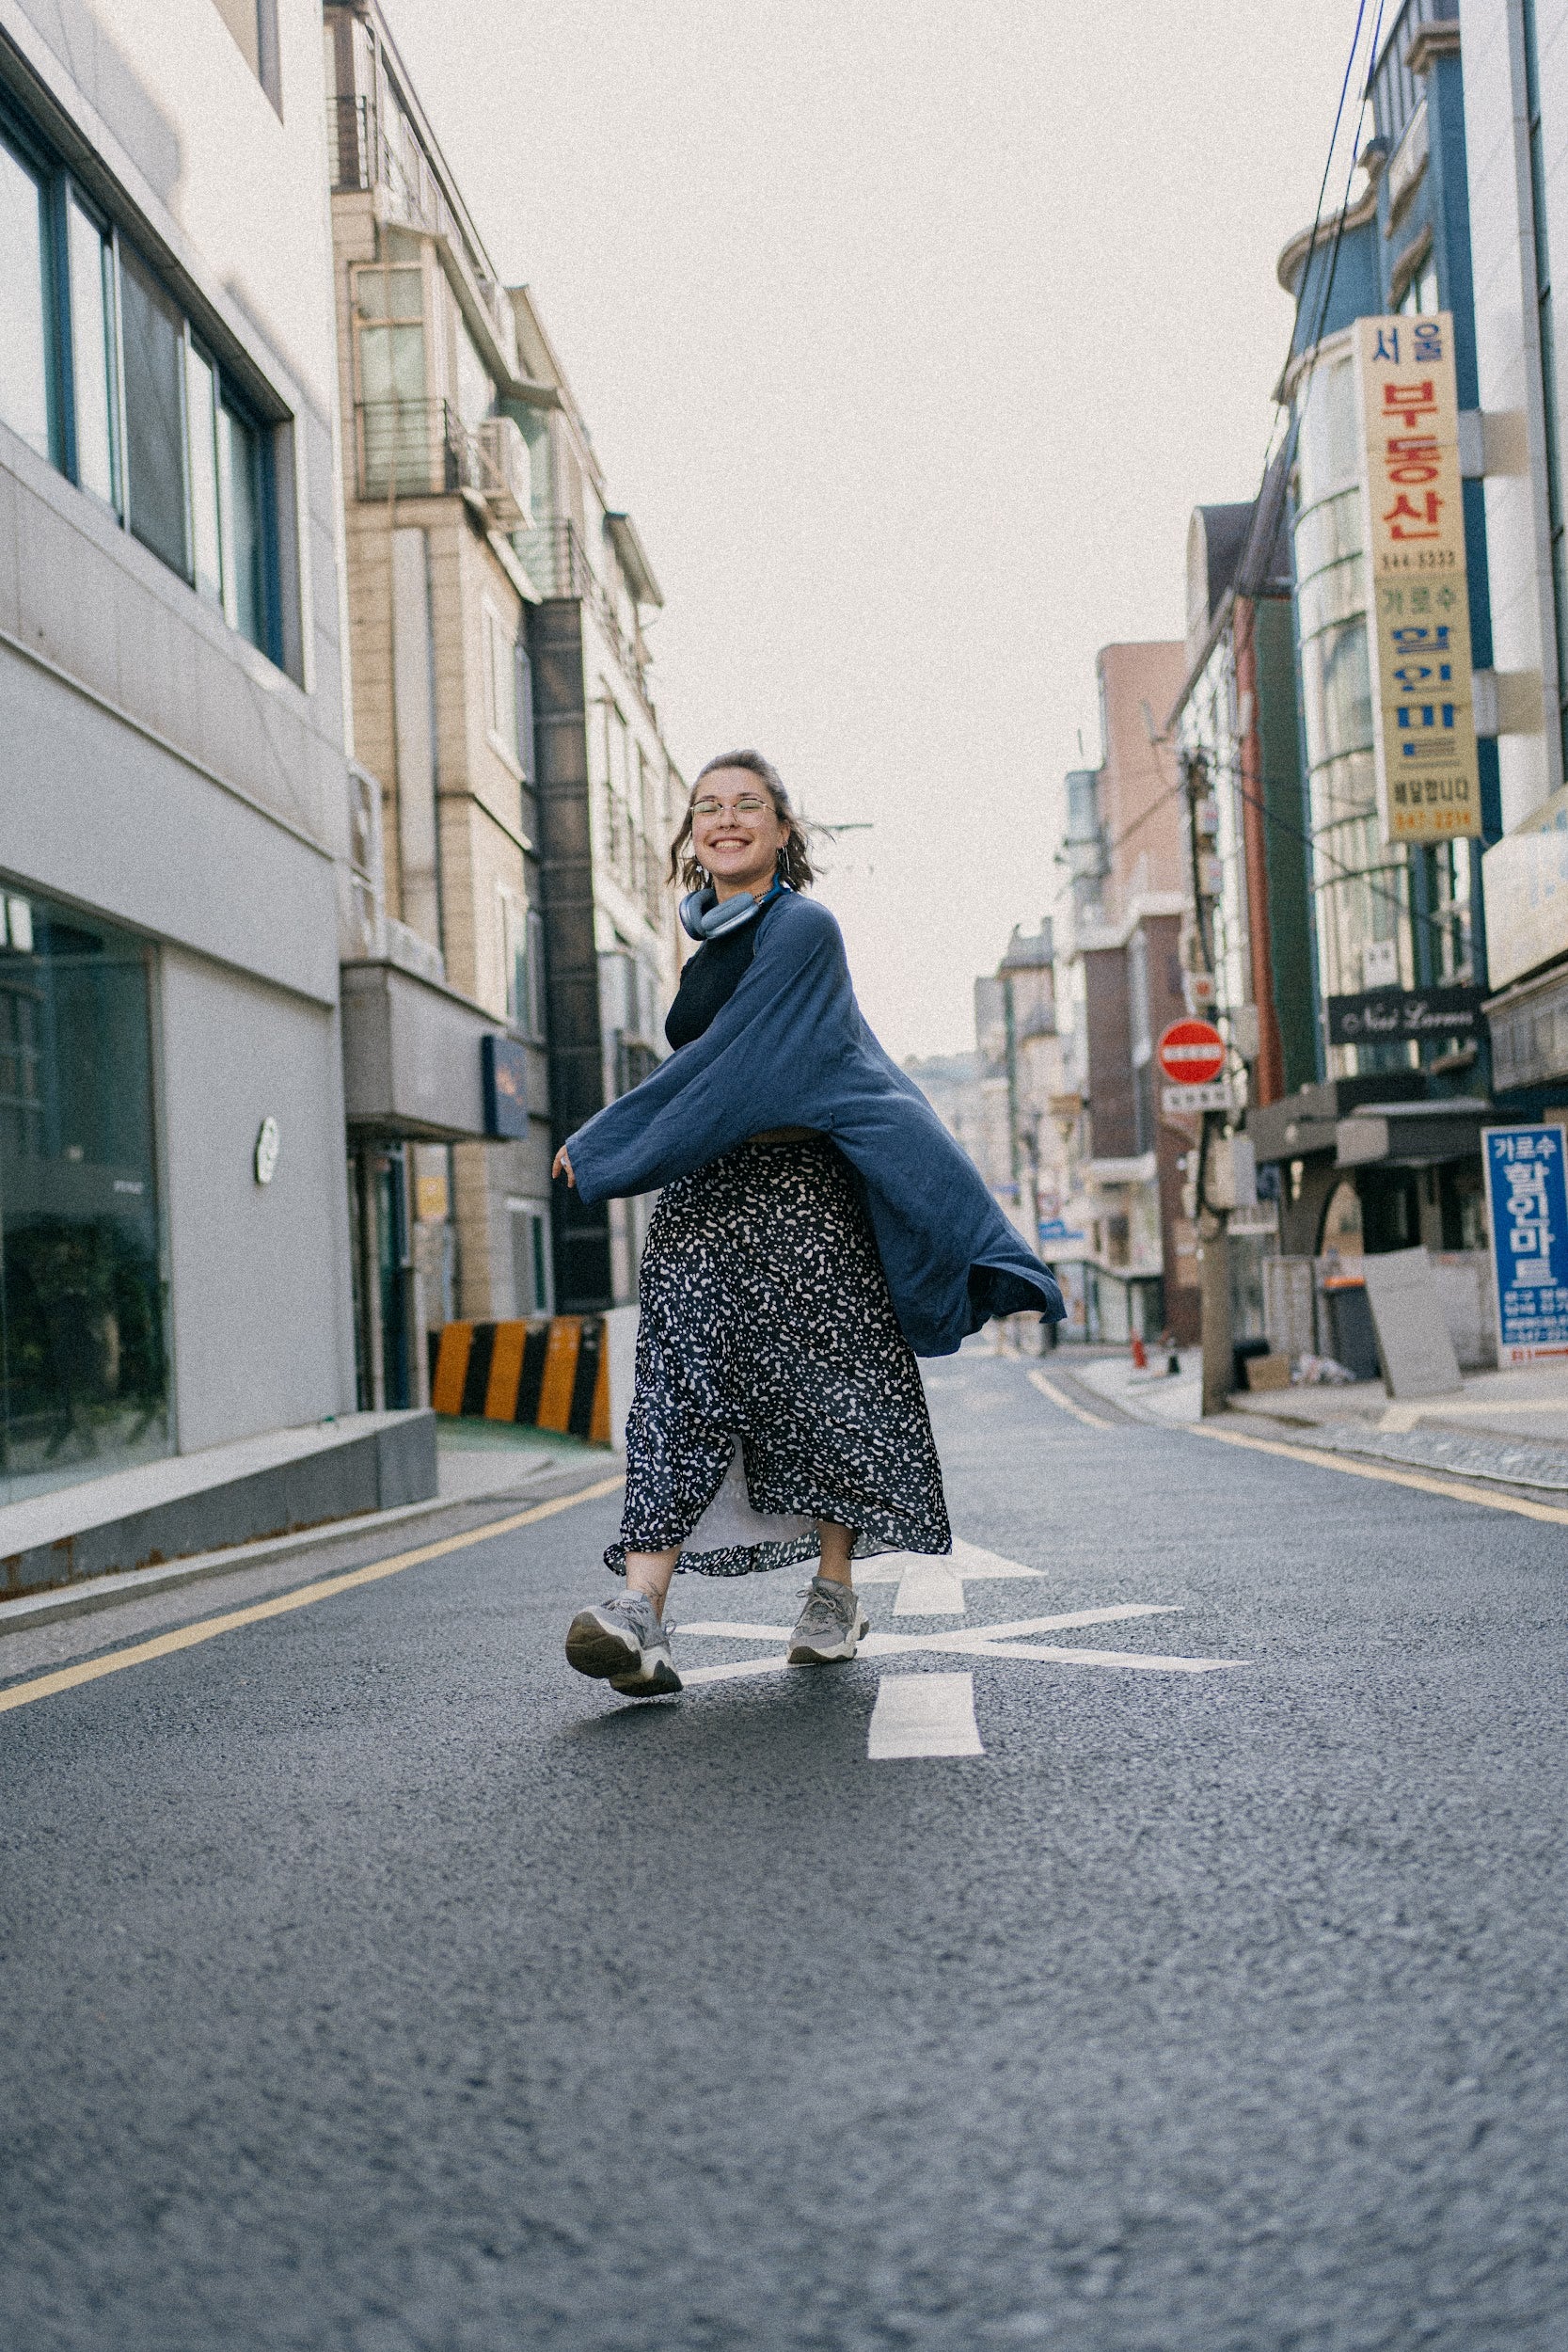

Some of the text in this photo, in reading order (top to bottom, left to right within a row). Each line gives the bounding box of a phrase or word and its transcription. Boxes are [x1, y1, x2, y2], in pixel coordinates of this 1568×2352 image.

[1373, 323, 1443, 364] 서울
[1382, 379, 1445, 542] 부동산
[1383, 586, 1457, 615] 가로수
[1391, 626, 1463, 770] 할인마트
[1494, 1135, 1558, 1162] 가로수
[1503, 1161, 1559, 1288] 할인마트
